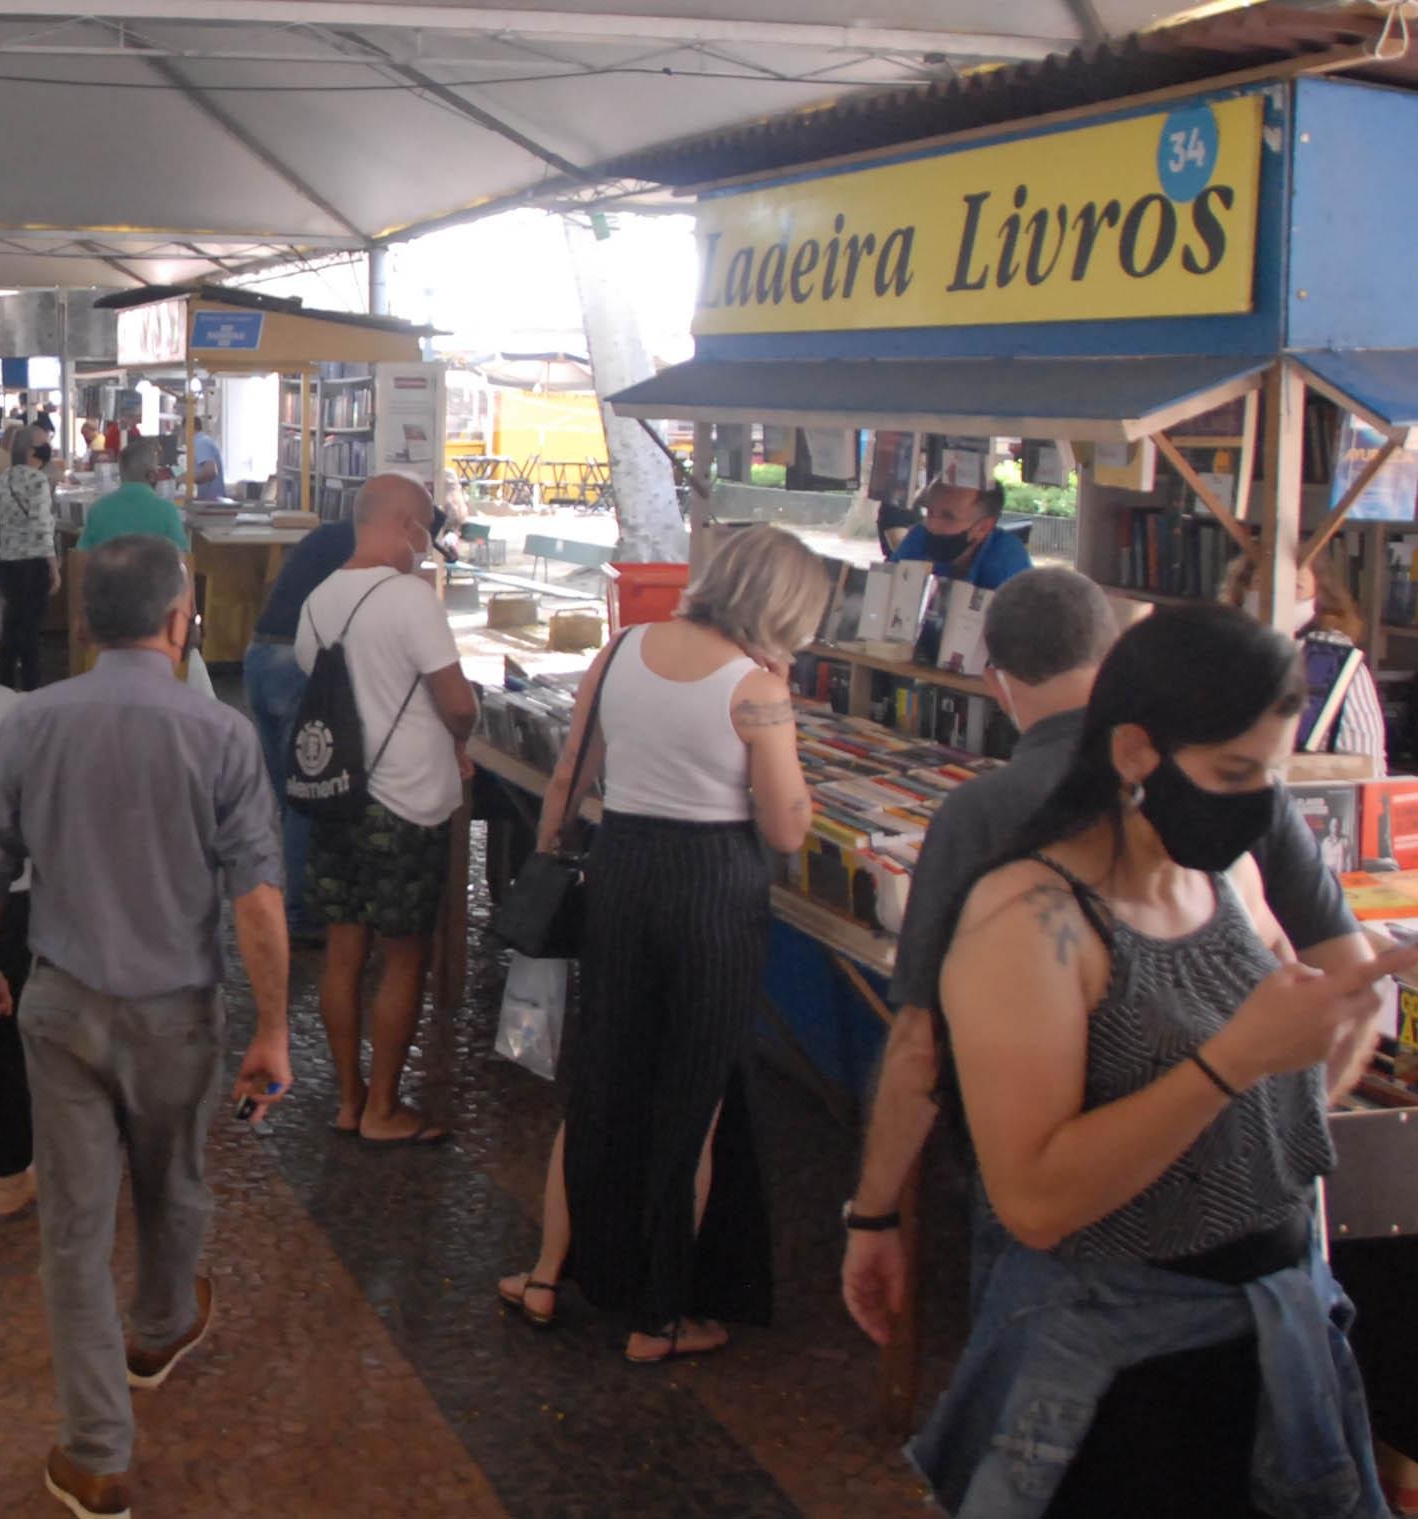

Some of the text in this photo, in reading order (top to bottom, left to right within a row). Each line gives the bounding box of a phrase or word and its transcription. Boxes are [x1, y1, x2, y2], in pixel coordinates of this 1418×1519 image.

[1168, 127, 1207, 173] 34
[696, 184, 1236, 309] Ladeira Livros
